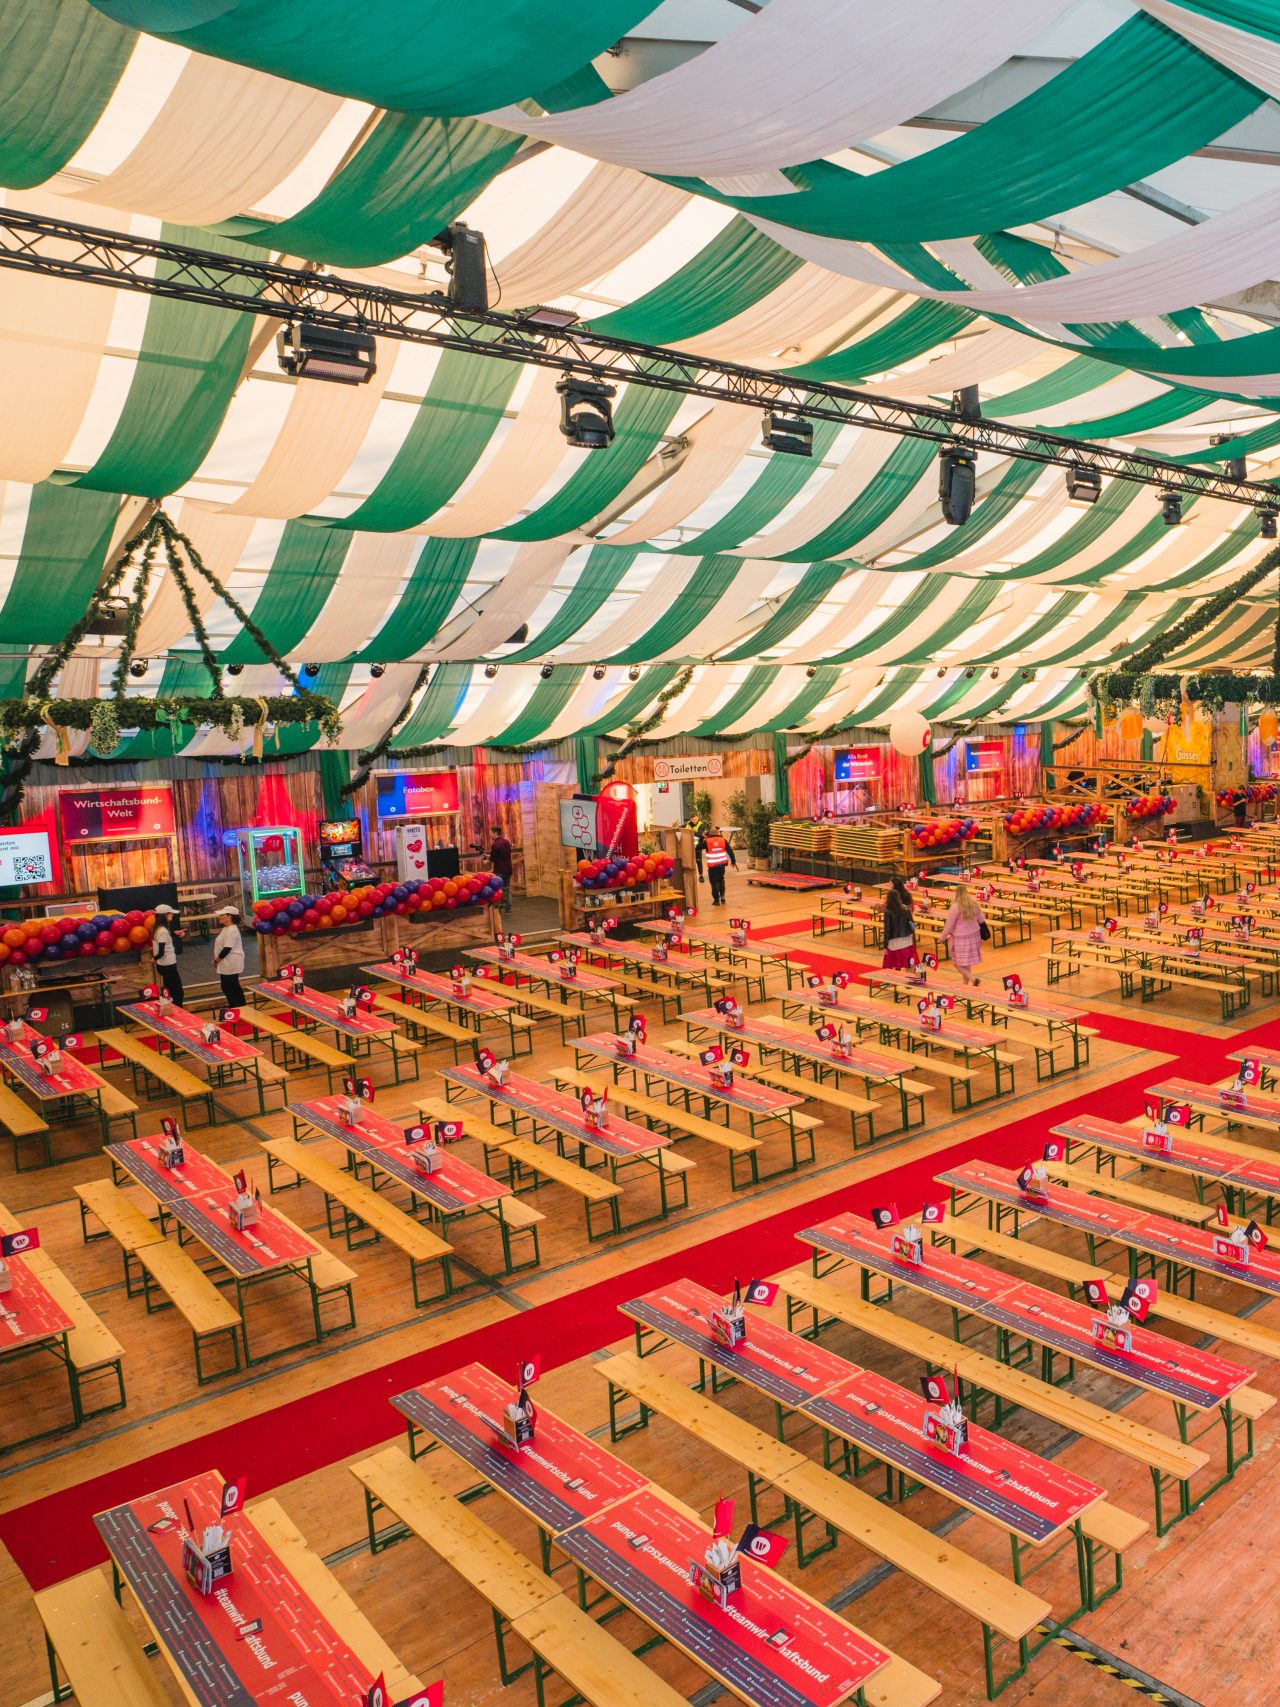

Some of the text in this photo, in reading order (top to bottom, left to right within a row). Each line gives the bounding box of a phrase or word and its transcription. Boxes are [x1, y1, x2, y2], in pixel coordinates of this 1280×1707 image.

[669, 765, 707, 774] Toiletten
[74, 797, 162, 809] Wirtschaftsbund-
[403, 786, 435, 794] Fotobox
[107, 809, 133, 818] Welt
[958, 1453, 1060, 1509] #teamwchaftsbund
[610, 1521, 695, 1588] #teamwirtschbund
[213, 1588, 278, 1670] #teamwirtaftsbund
[724, 1604, 830, 1683] #teamwirhaftsbund
